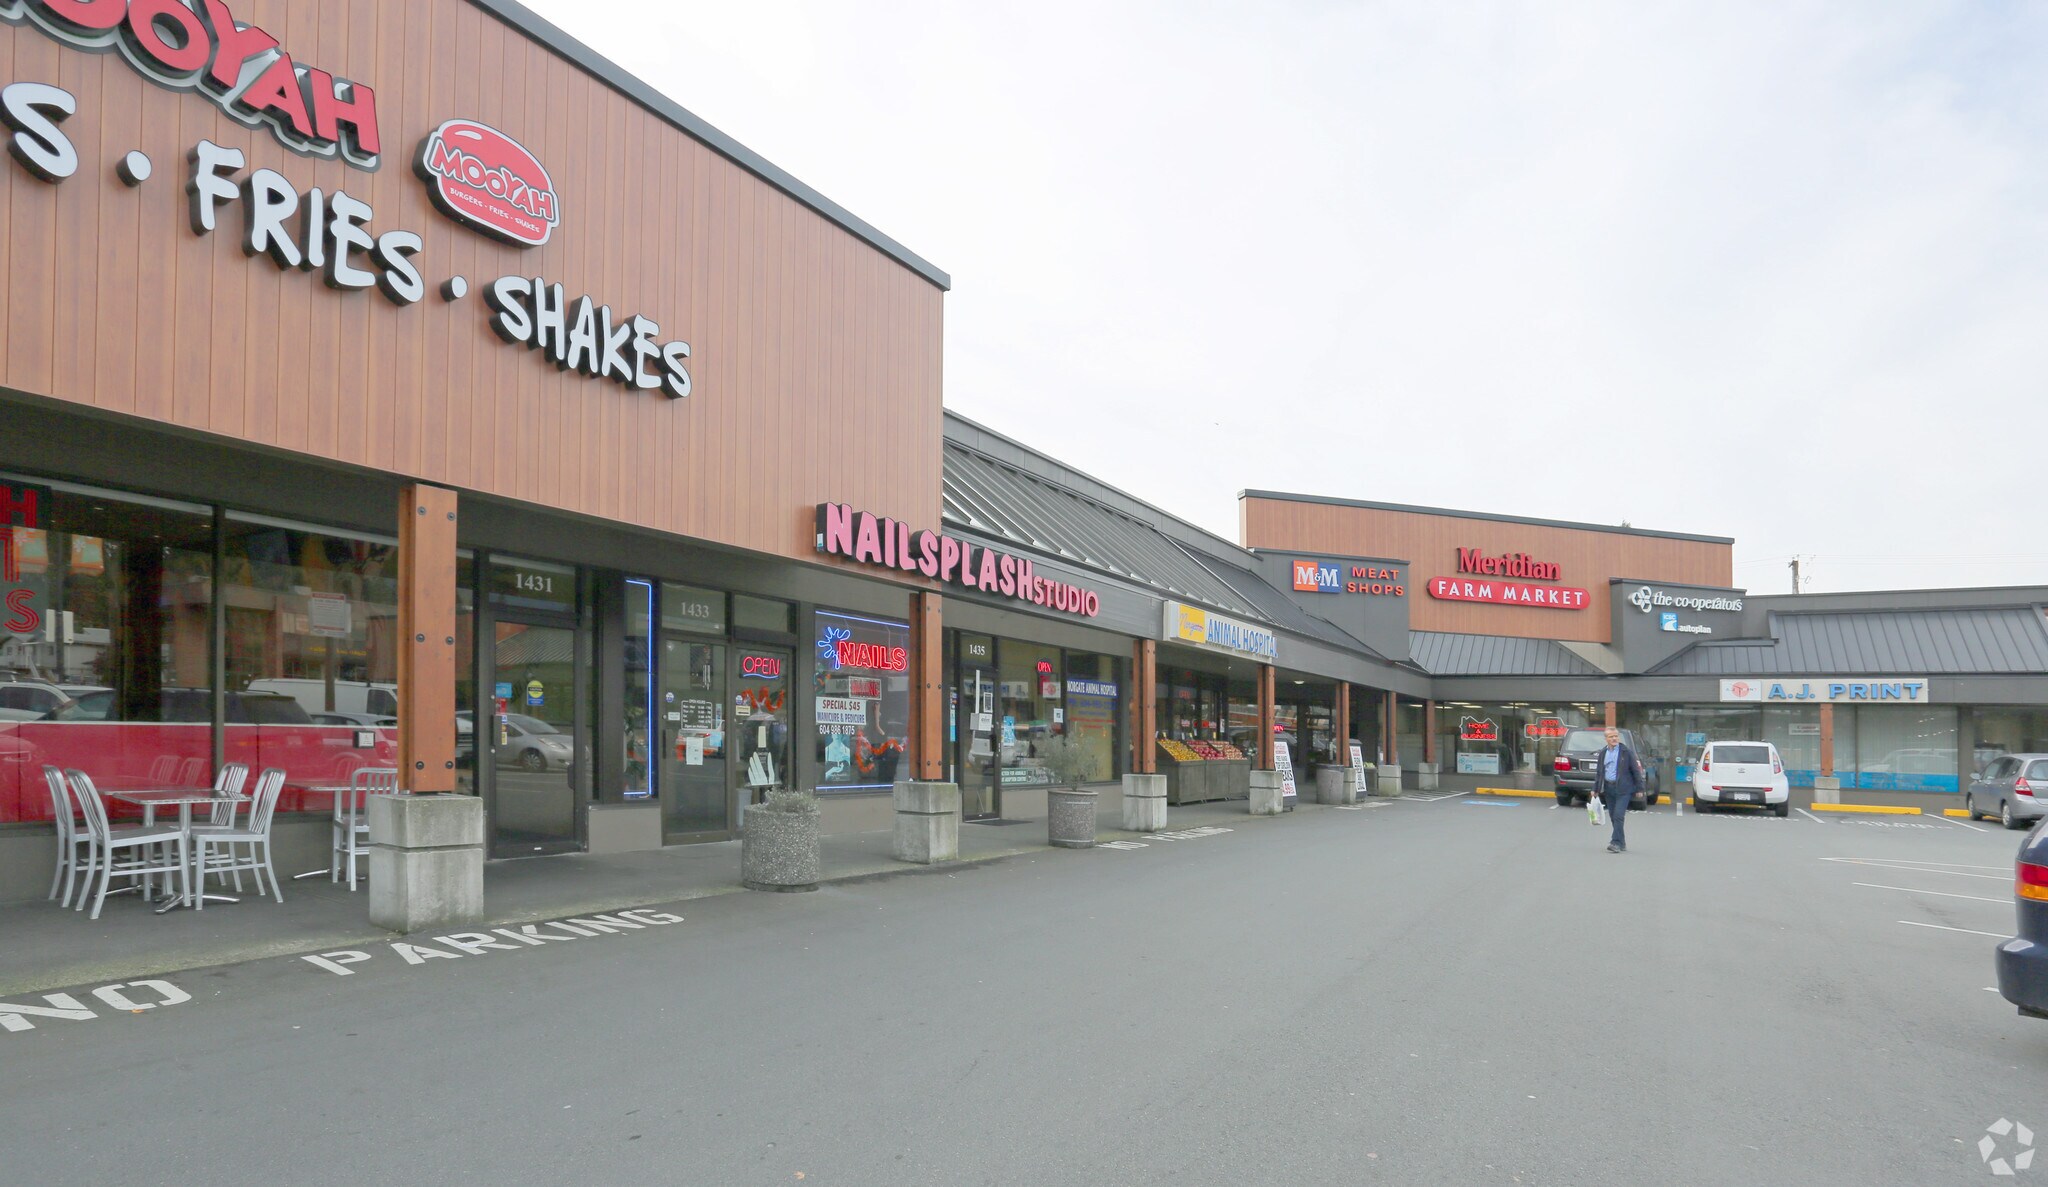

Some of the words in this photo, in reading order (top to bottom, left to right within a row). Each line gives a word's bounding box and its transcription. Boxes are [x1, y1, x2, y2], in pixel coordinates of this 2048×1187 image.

[0, 0, 381, 155] OYAH
[449, 187, 483, 208] BURGERS
[489, 205, 509, 219] FRIES
[196, 139, 423, 303] FRIES
[494, 275, 691, 398] SHAKES
[1459, 547, 1561, 580] Meridian
[1352, 566, 1400, 580] MEAT
[515, 573, 552, 593] 1431
[1347, 581, 1404, 597] SHOPS
[1438, 581, 1492, 599] FARM
[1503, 586, 1583, 605] MARKET
[1653, 591, 1672, 605] the
[1675, 597, 1743, 612] co-operators
[681, 602, 710, 618] 1433
[1207, 618, 1241, 649] ANIMAL
[1243, 628, 1279, 658] HOSPITAL
[1679, 625, 1712, 635] autoplan
[838, 641, 907, 671] NAILS
[969, 644, 986, 656] 1435
[742, 656, 781, 675] OPEN
[1037, 660, 1053, 673] OPEN
[1066, 680, 1085, 693] NORGATE
[1085, 682, 1100, 695] ANIMAL
[1100, 684, 1117, 696] HOSPITAL
[1768, 683, 1816, 700] A.J.
[1828, 683, 1923, 700] PRINT
[822, 699, 848, 710] SPECIAL
[817, 711, 840, 722] MANICURE
[845, 713, 865, 724] PEDICURE
[819, 725, 830, 735] 604
[842, 725, 855, 736] 1875
[0, 978, 192, 1032] NO
[301, 909, 686, 976] PARKING
